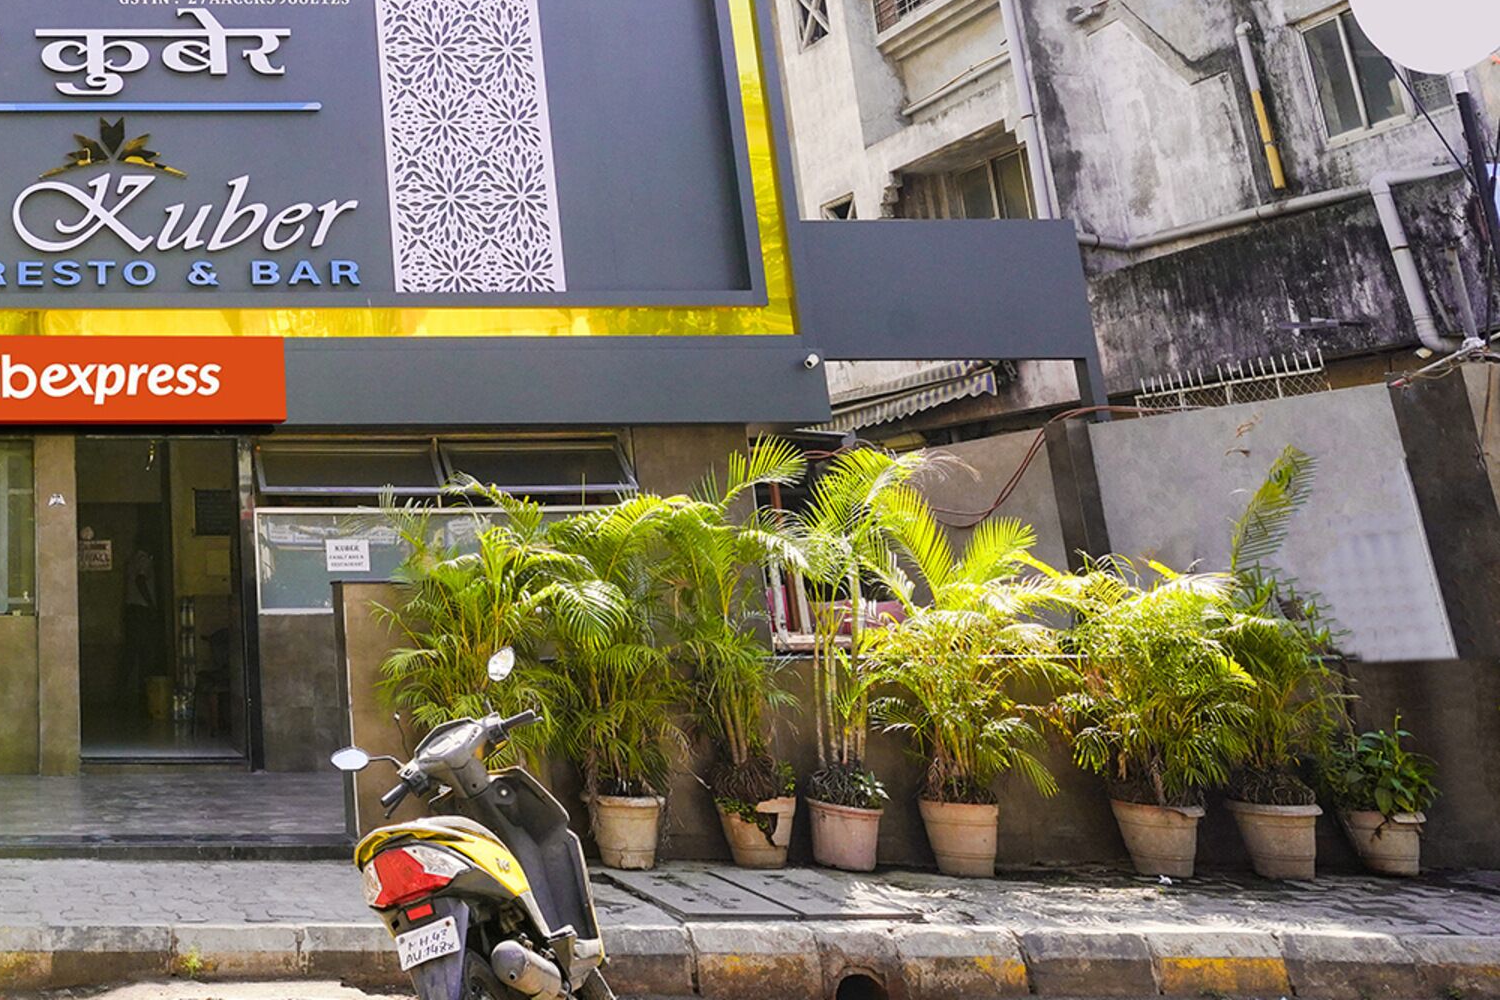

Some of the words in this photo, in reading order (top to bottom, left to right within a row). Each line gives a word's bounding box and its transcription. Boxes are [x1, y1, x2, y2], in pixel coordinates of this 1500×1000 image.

[34, 8, 291, 96] कुबेर
[12, 173, 359, 253] Kuber
[186, 260, 220, 286] &
[250, 260, 361, 286] BAR
